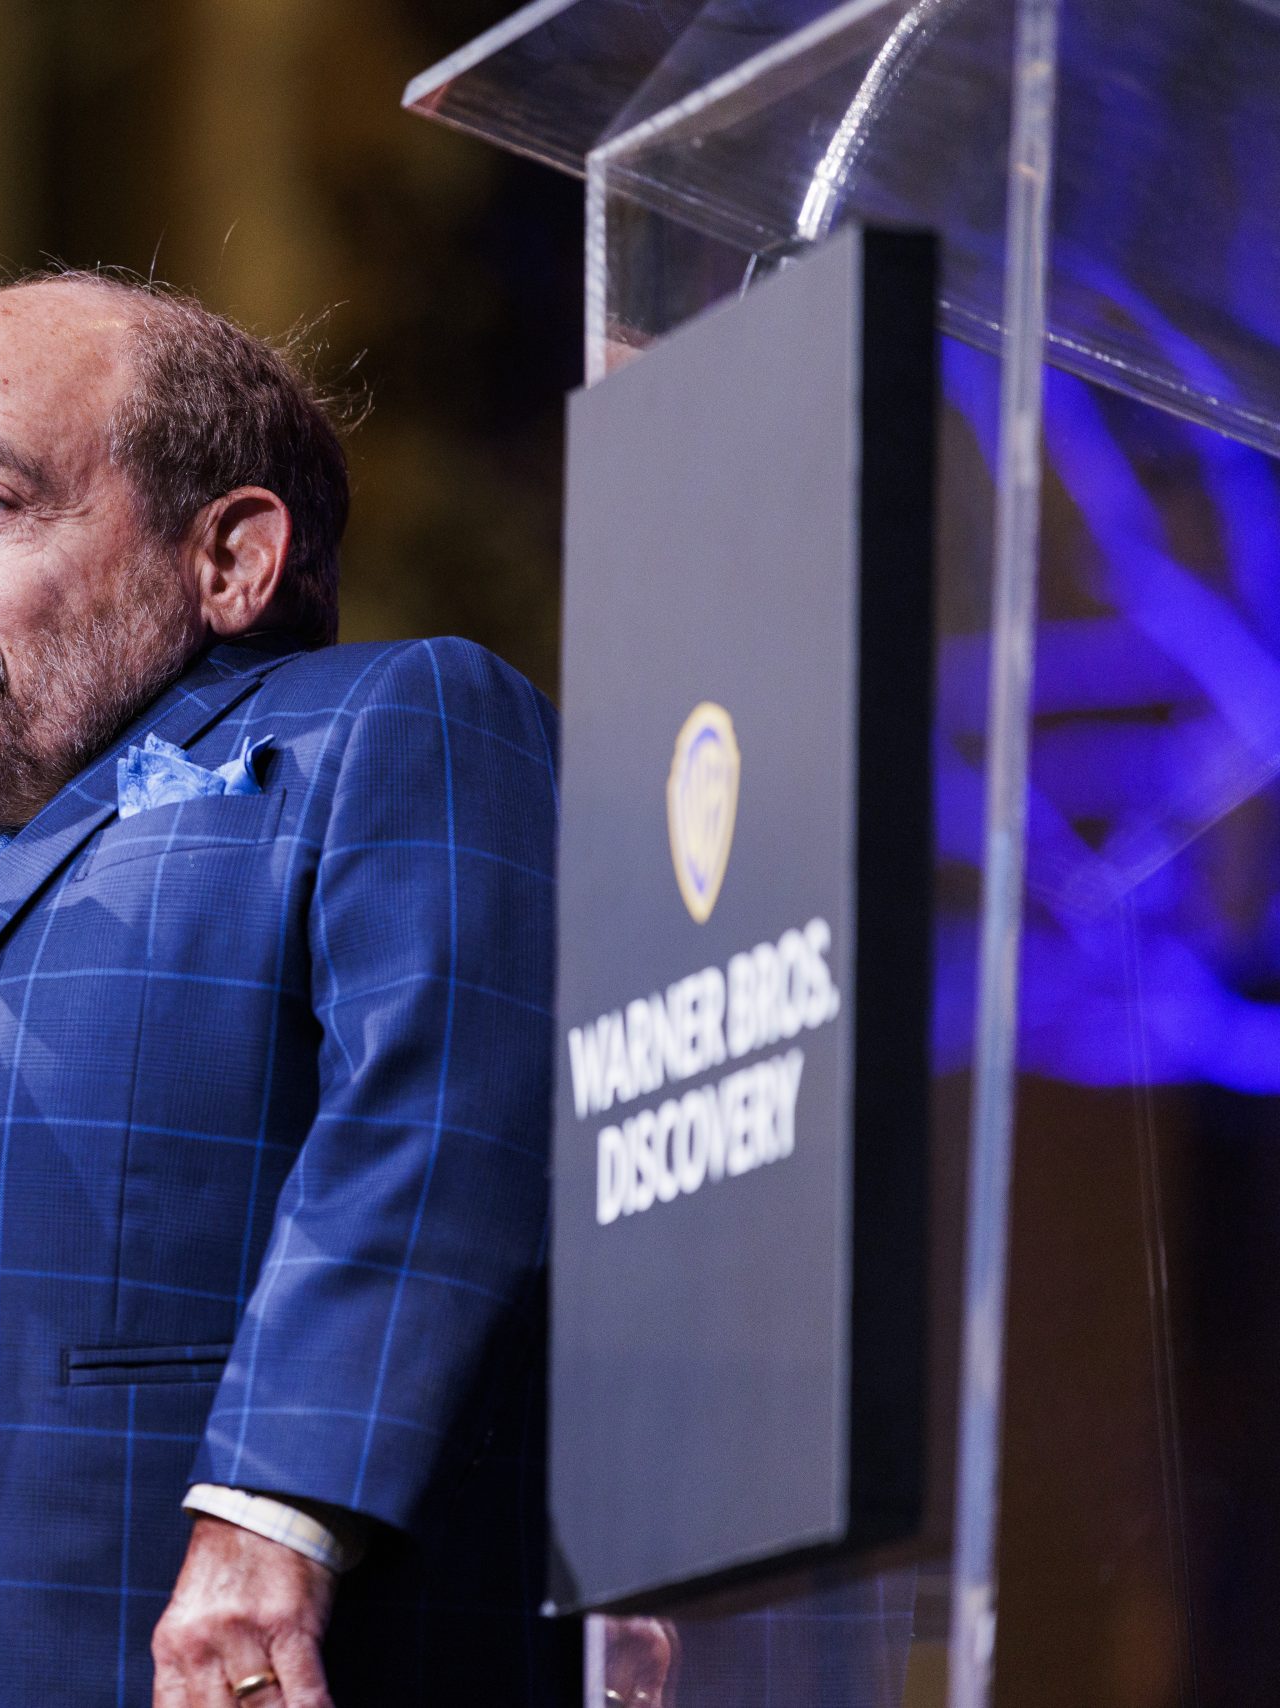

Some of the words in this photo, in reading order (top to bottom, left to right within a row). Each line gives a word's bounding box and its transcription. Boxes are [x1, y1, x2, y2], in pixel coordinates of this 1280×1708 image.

[568, 966, 727, 1118] WARNER
[727, 918, 840, 1060] BROS.
[597, 1048, 805, 1225] DISCOVERY
